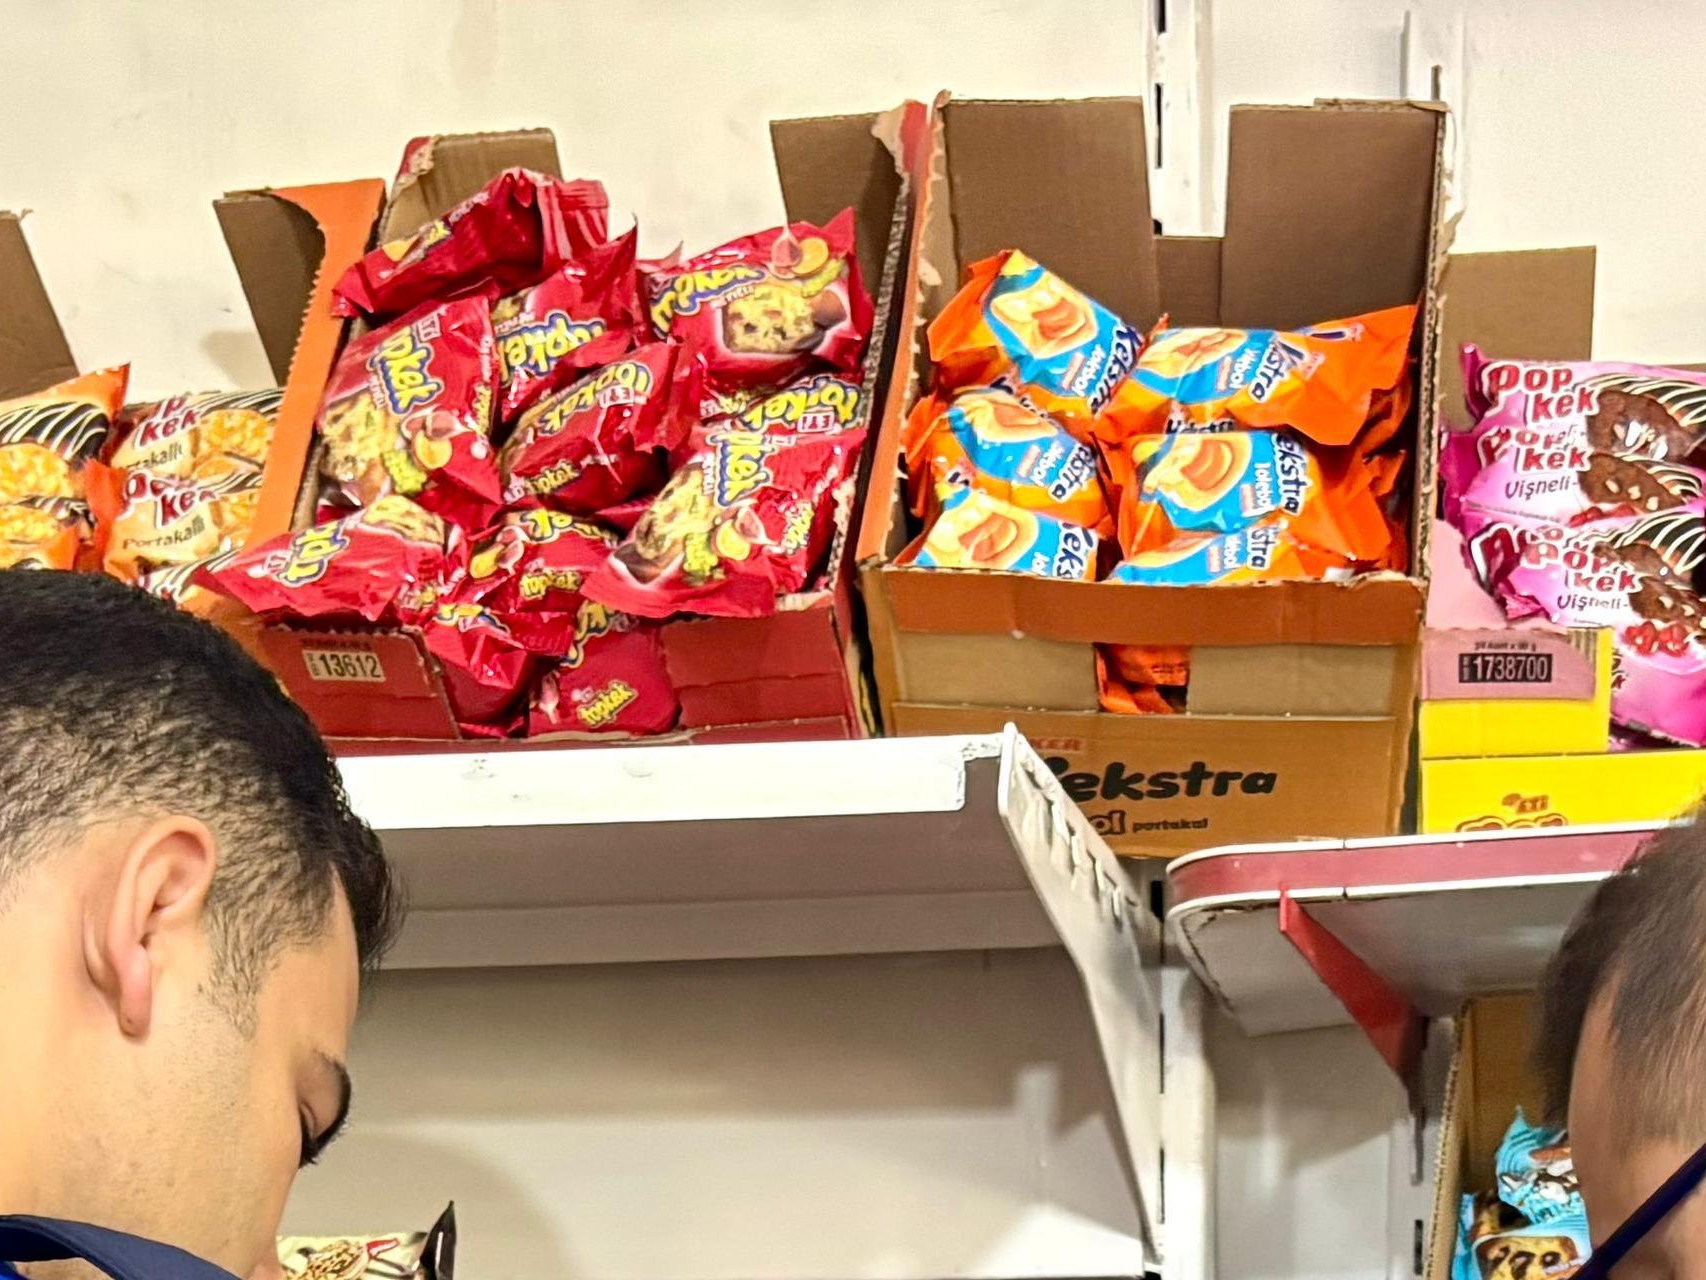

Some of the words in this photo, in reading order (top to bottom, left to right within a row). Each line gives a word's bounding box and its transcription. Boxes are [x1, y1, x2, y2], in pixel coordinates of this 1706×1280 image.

[1526, 385, 1601, 424] kek
[1516, 442, 1591, 473] kek
[1472, 655, 1550, 683] 1738700
